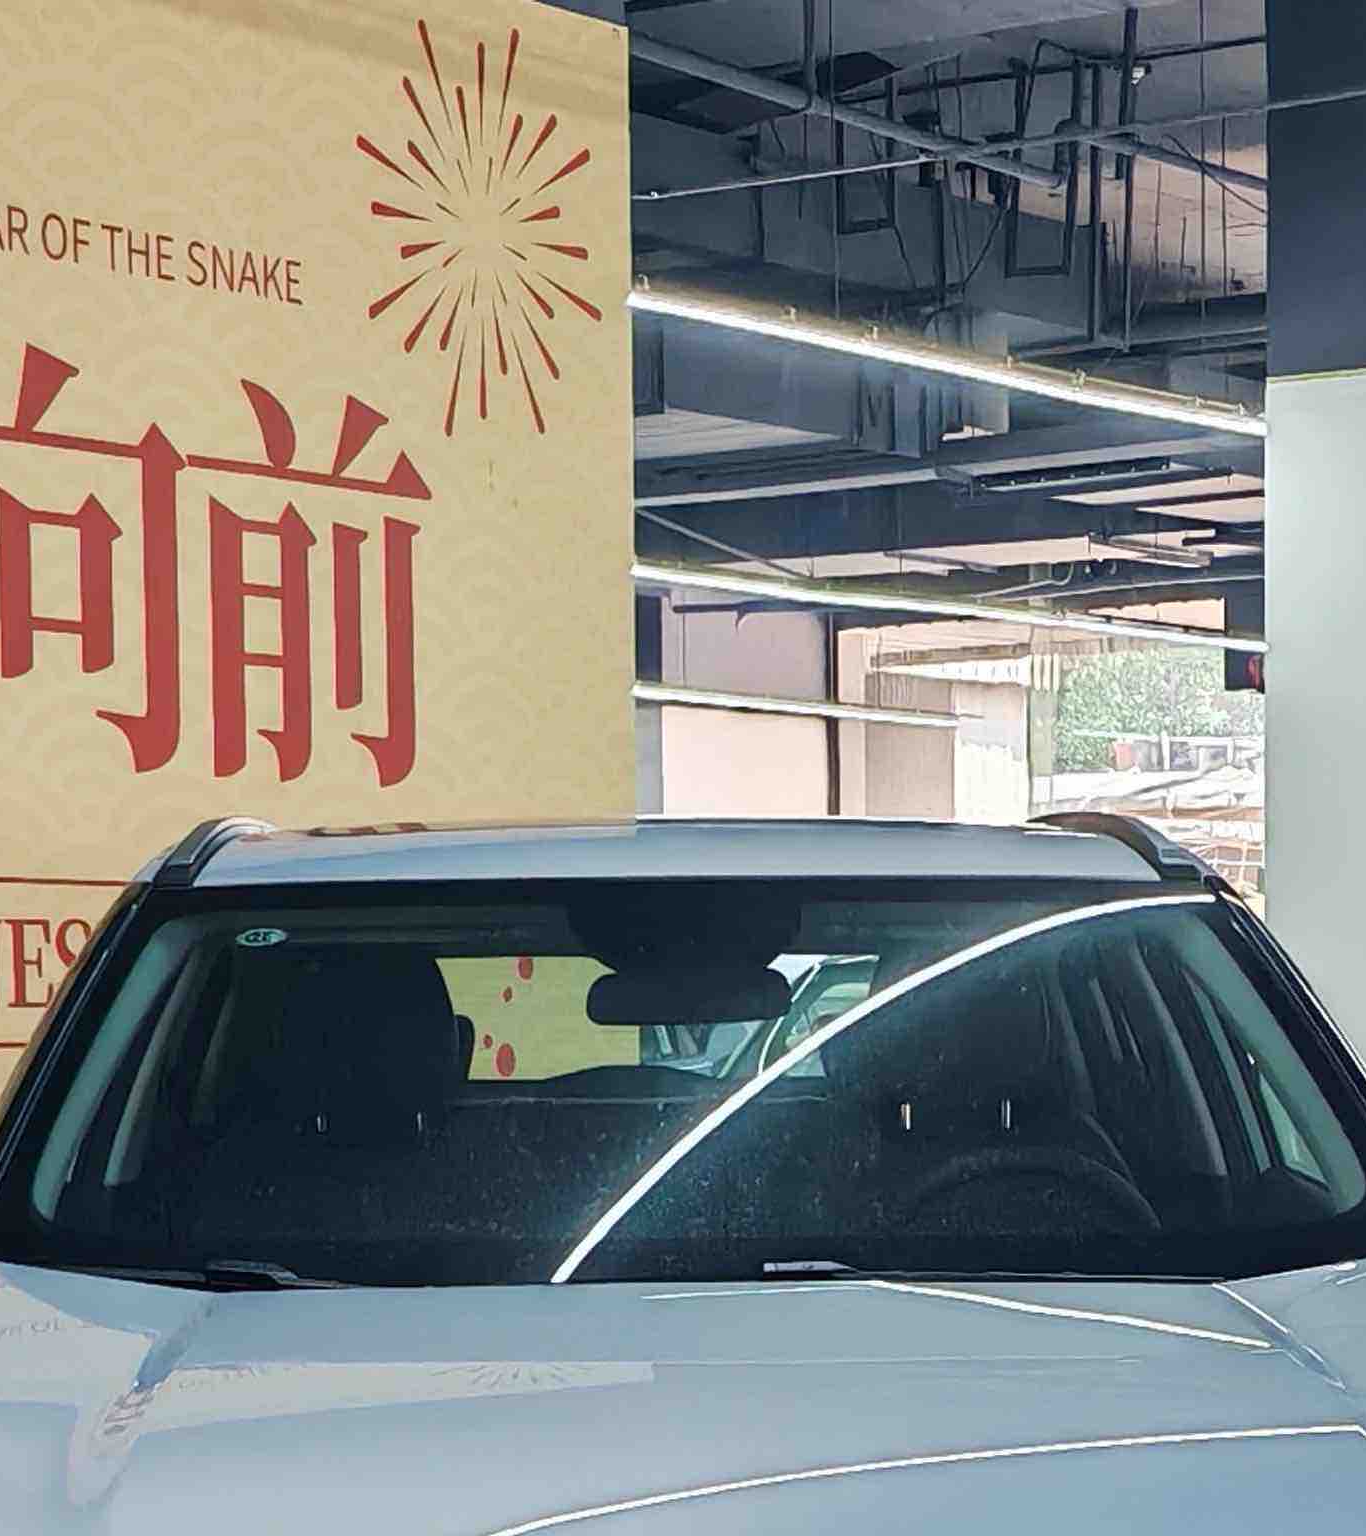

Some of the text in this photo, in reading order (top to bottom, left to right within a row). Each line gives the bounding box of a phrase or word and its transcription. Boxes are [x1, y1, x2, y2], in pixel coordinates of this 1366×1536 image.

[41, 212, 92, 264] OF
[100, 223, 176, 281] THE
[186, 240, 304, 305] SNAKE
